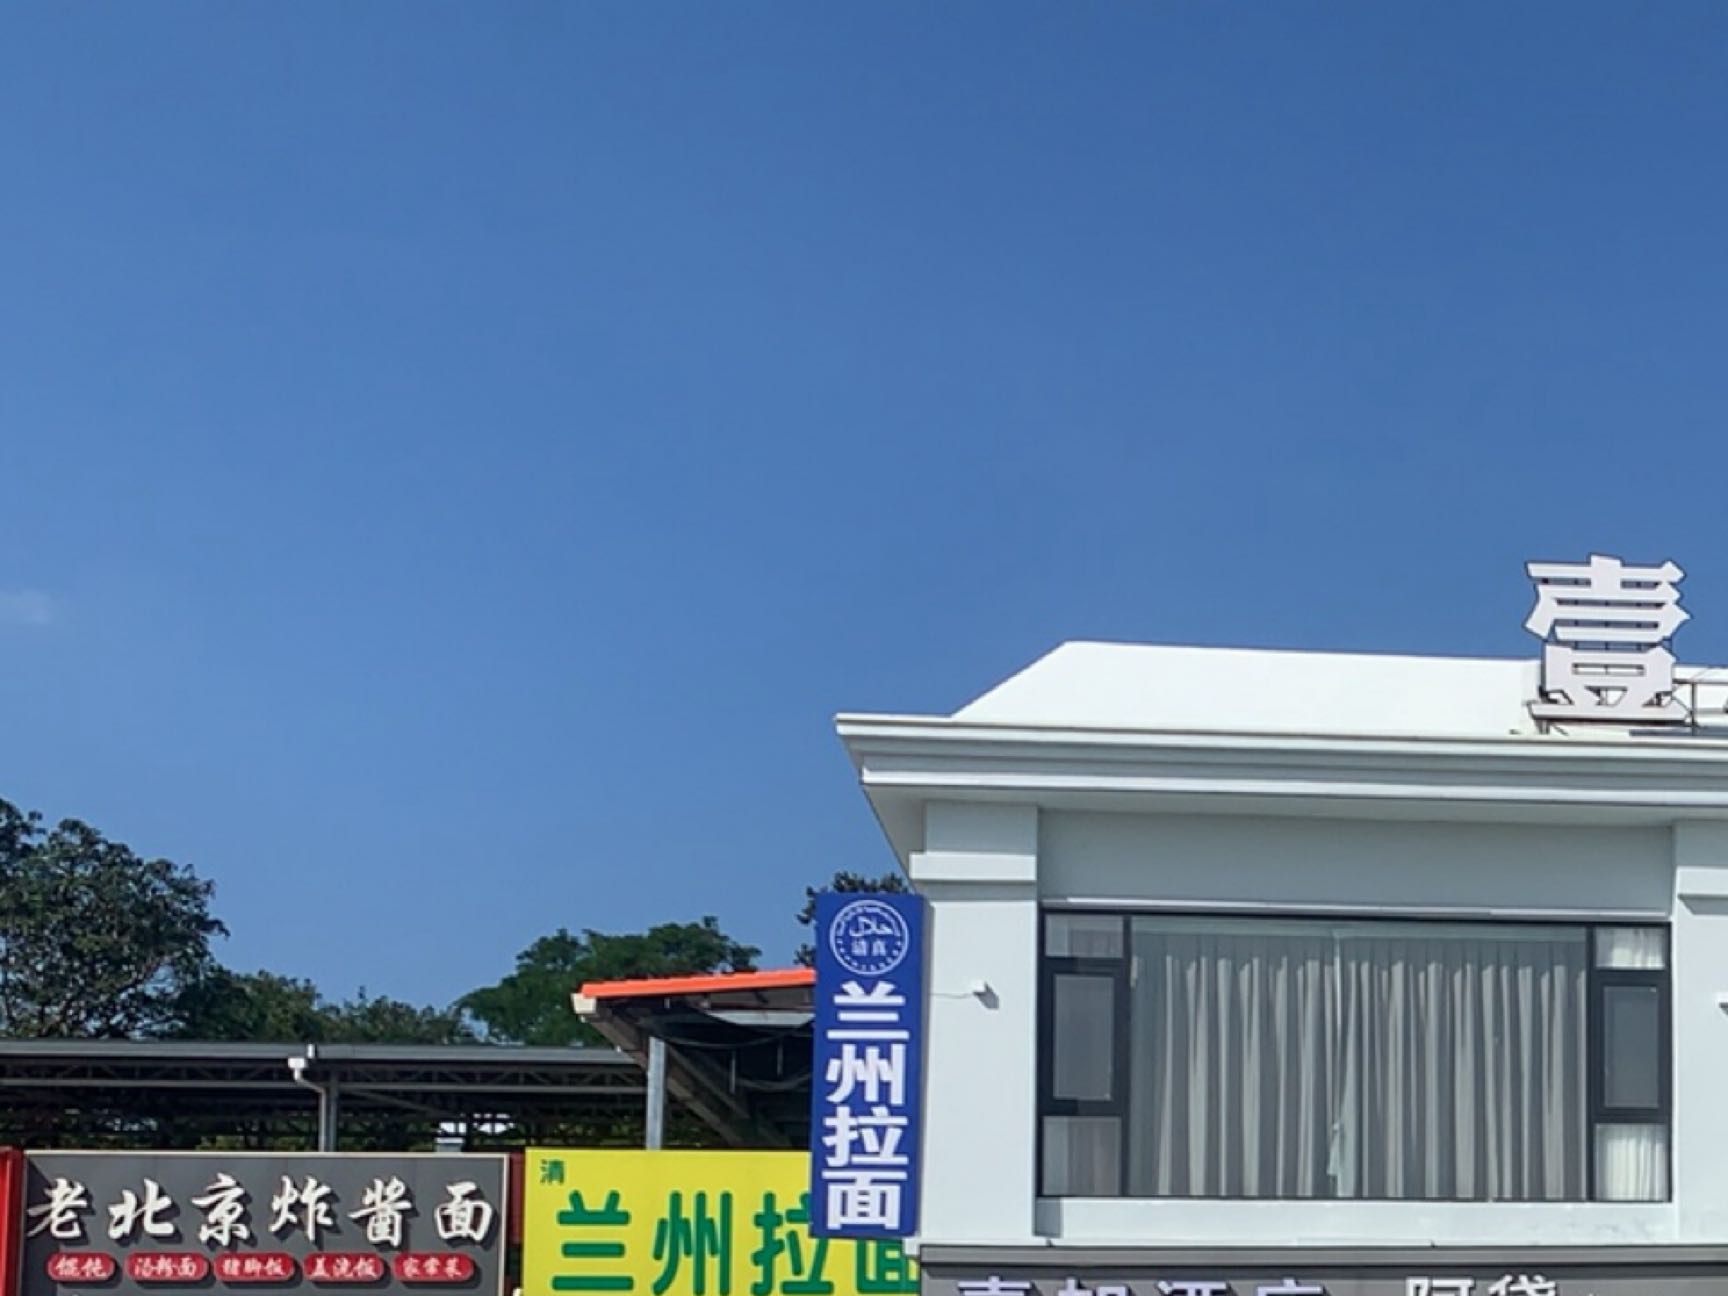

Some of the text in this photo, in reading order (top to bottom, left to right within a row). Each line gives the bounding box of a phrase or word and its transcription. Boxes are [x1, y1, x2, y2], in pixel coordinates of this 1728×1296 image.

[822, 981, 910, 1231] 兰州拉面
[540, 1158, 565, 1184] 清
[27, 1173, 495, 1248] 老北京炸酱面
